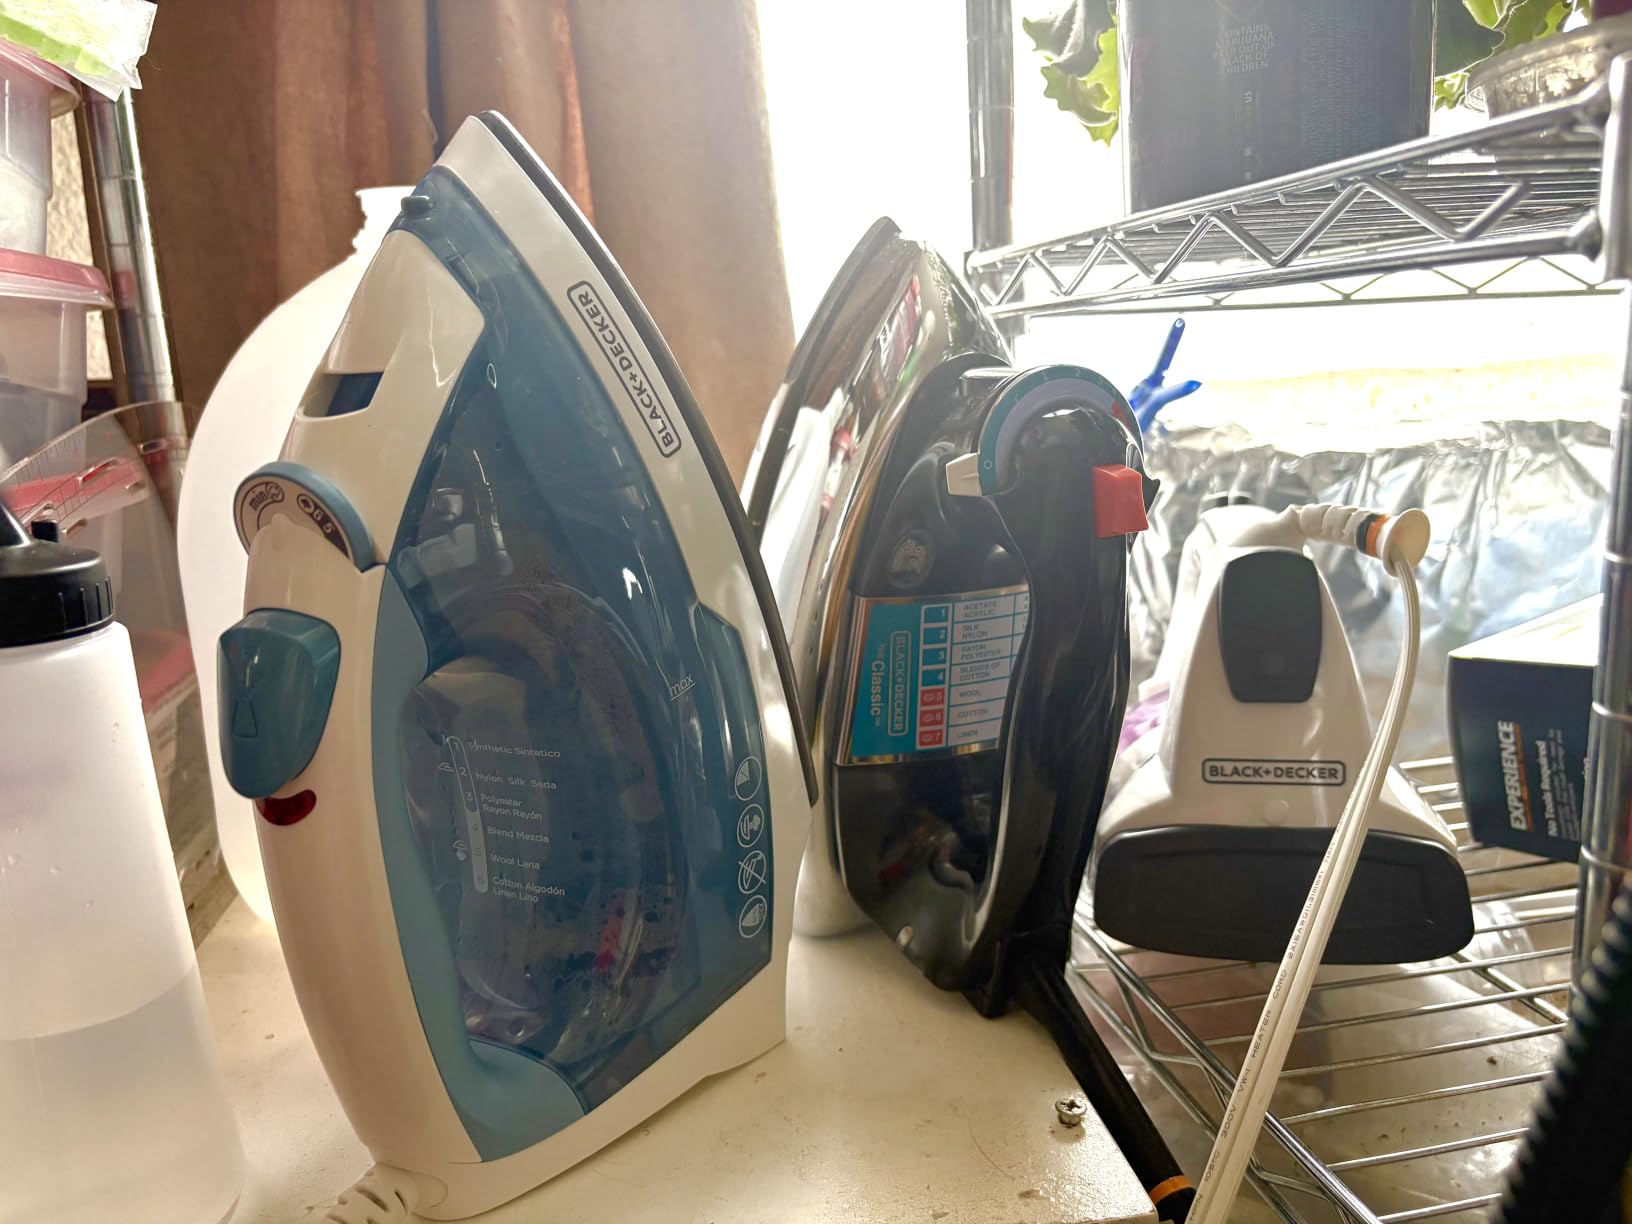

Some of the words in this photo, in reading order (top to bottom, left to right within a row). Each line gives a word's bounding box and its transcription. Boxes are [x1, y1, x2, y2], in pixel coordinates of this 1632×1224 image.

[578, 290, 674, 448] BLACK+DECKER
[249, 489, 269, 511] min
[323, 523, 335, 534] 5
[669, 674, 694, 697] max
[871, 660, 886, 717] Classic
[895, 636, 907, 730] BLACK+DECKER
[1209, 765, 1339, 780] BLACK+DECKER
[1498, 720, 1528, 831] EXPERIENCE
[1535, 740, 1551, 790] Required
[480, 793, 522, 807] Polyester
[482, 804, 511, 815] Rayon
[487, 825, 514, 838] Blend
[516, 831, 550, 843] Mezcla
[490, 853, 515, 866] Wool
[517, 859, 541, 870] Lana
[492, 876, 523, 889] Cotton
[525, 881, 566, 898] Algodón
[519, 891, 539, 903] Lino
[1220, 1105, 1236, 1139] 300V
[1238, 1068, 1251, 1093] VW-1
[1250, 1009, 1272, 1058] HEATER
[1272, 968, 1287, 999] CORD
